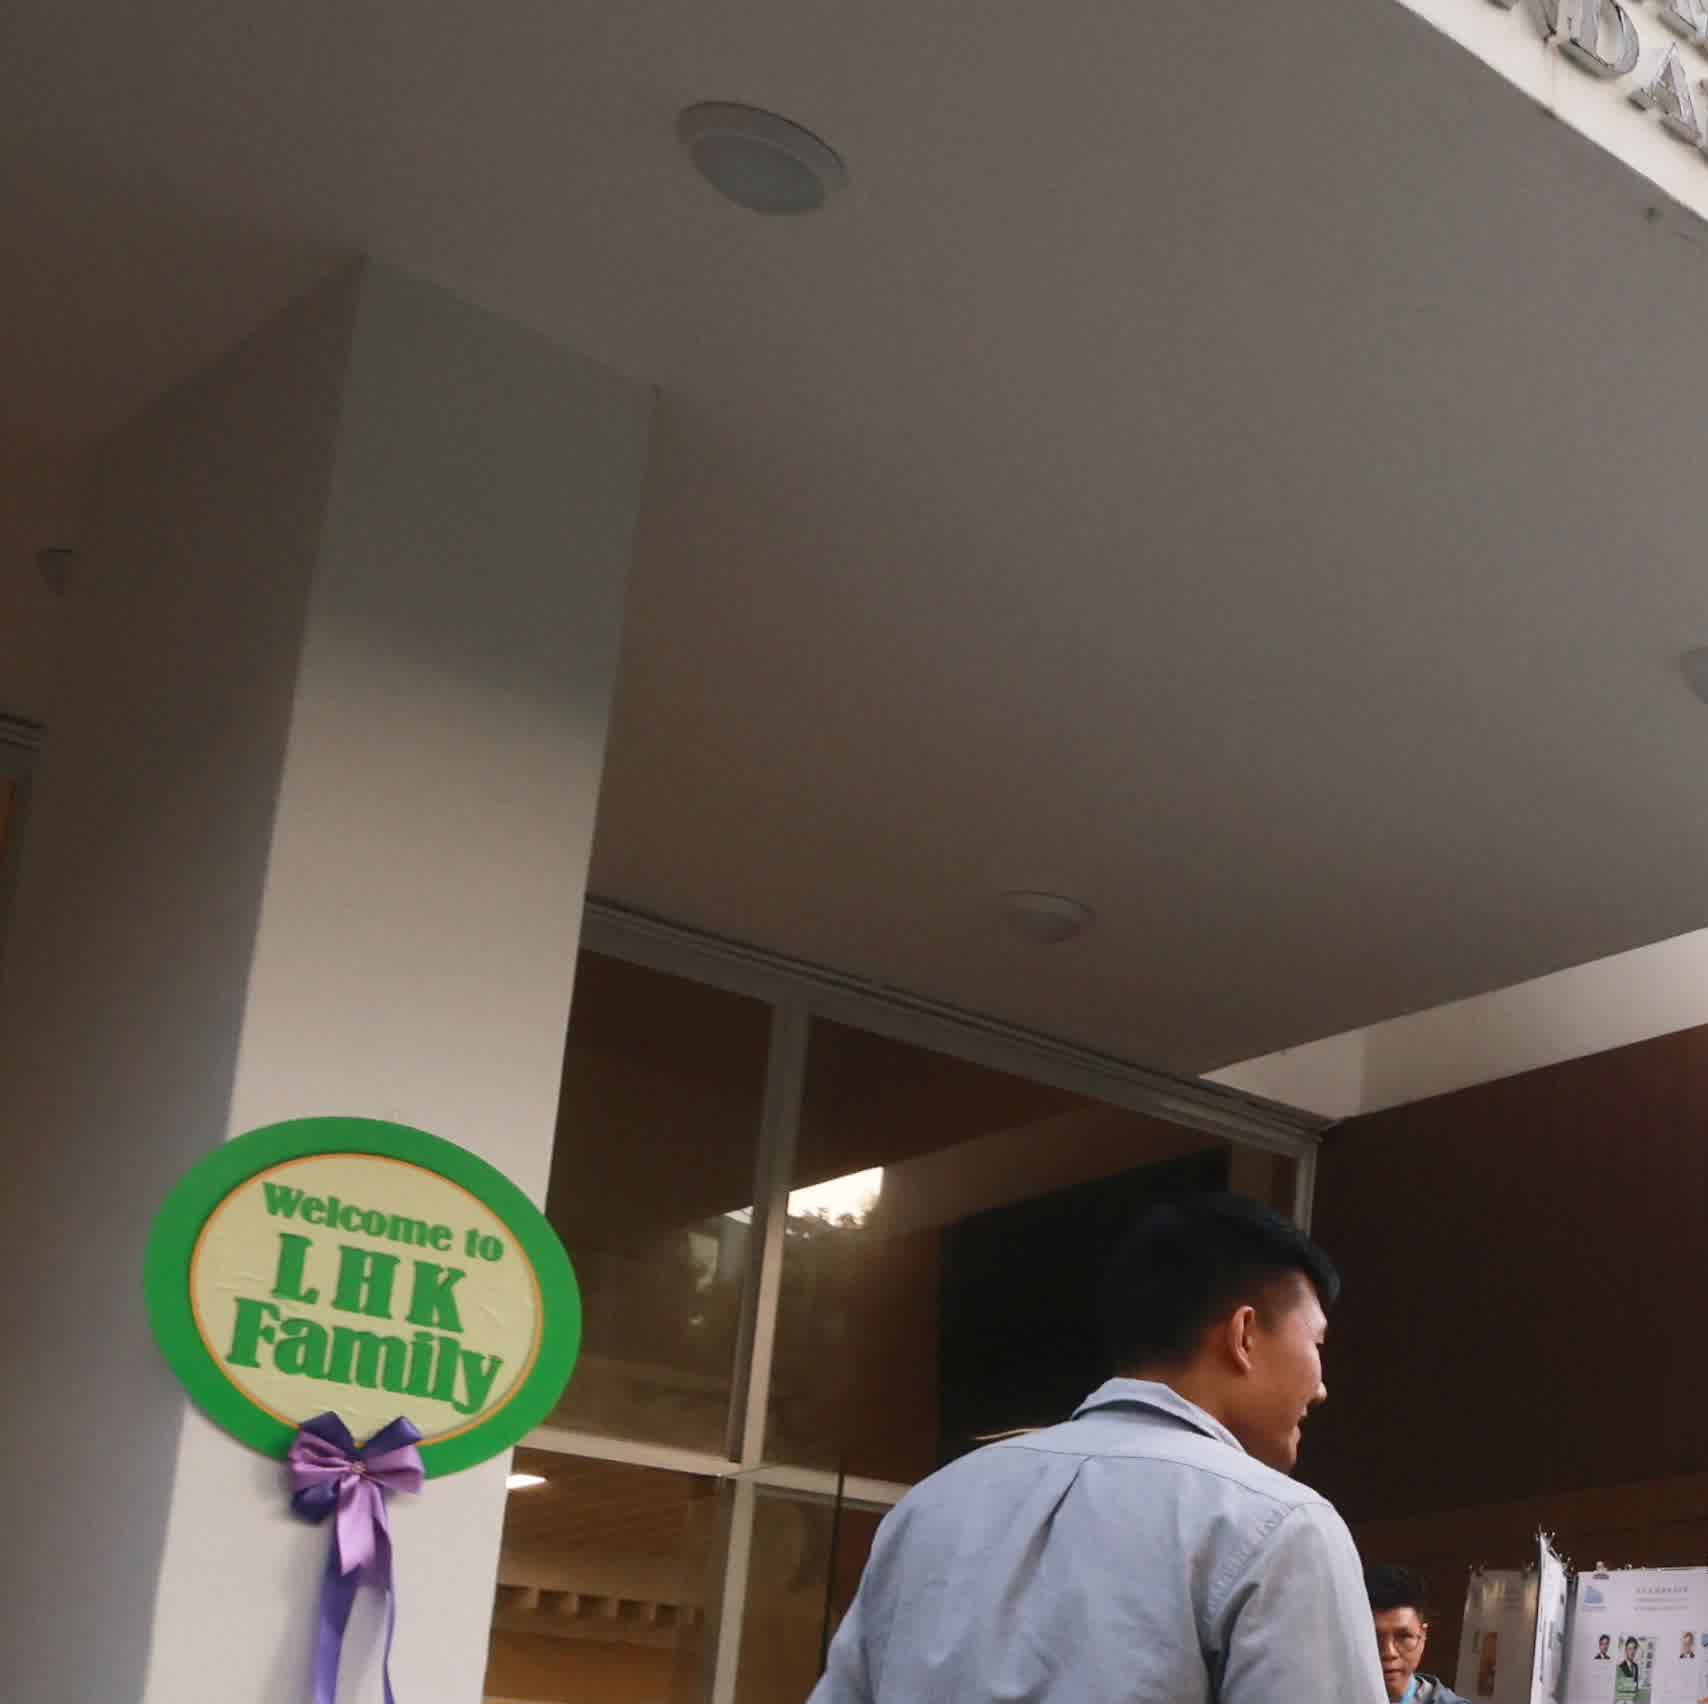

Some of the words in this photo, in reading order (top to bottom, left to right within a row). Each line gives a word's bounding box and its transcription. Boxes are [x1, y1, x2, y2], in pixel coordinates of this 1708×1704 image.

[262, 1181, 453, 1252] Welcome
[465, 1227, 504, 1262] to
[225, 1296, 504, 1415] Family
